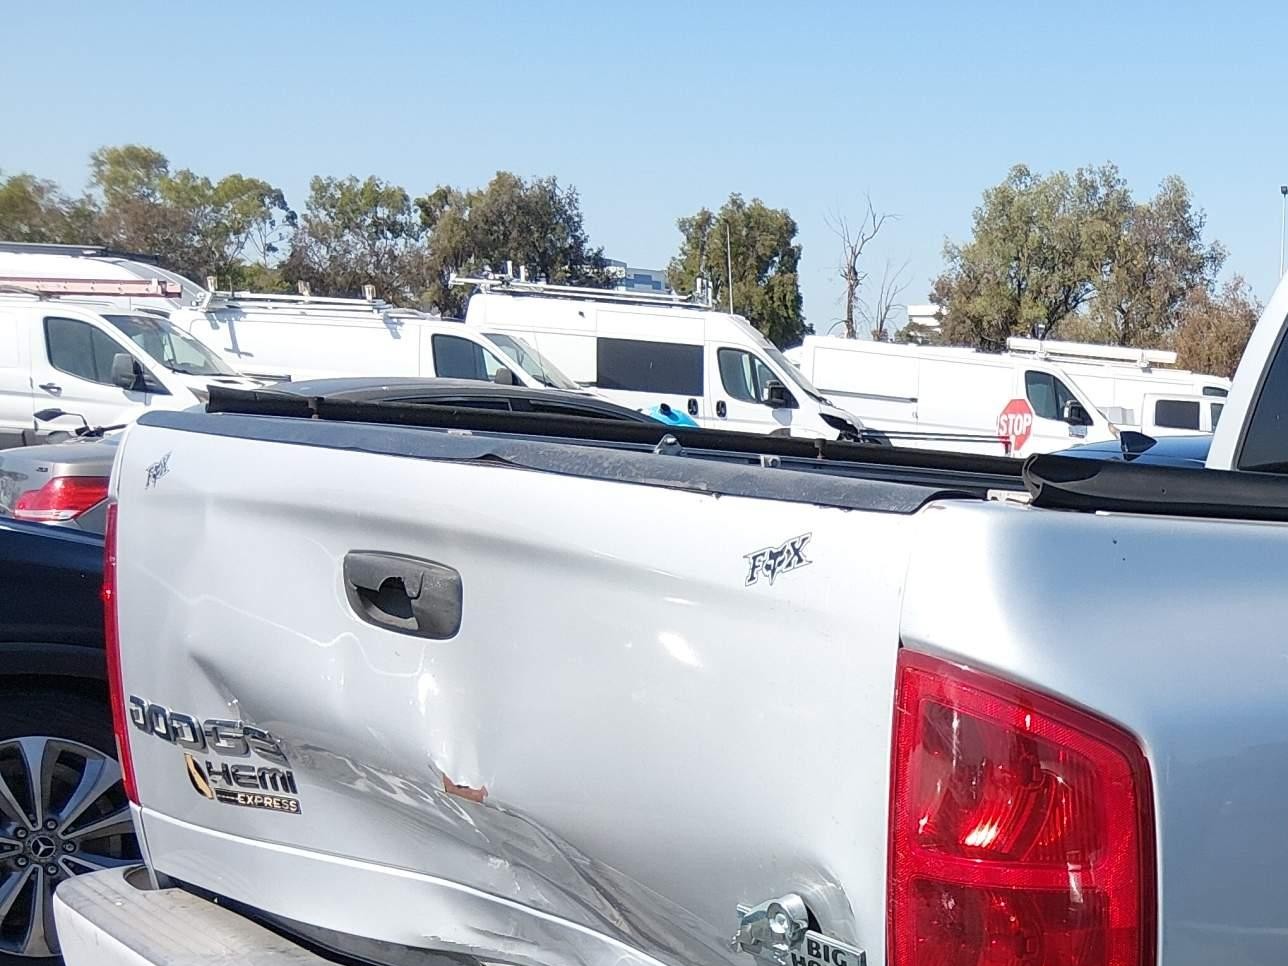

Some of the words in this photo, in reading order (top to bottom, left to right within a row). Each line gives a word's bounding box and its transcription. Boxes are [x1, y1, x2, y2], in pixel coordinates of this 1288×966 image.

[999, 412, 1032, 436] STOP
[205, 760, 298, 795] HEMI
[237, 793, 298, 812] EXPRESS
